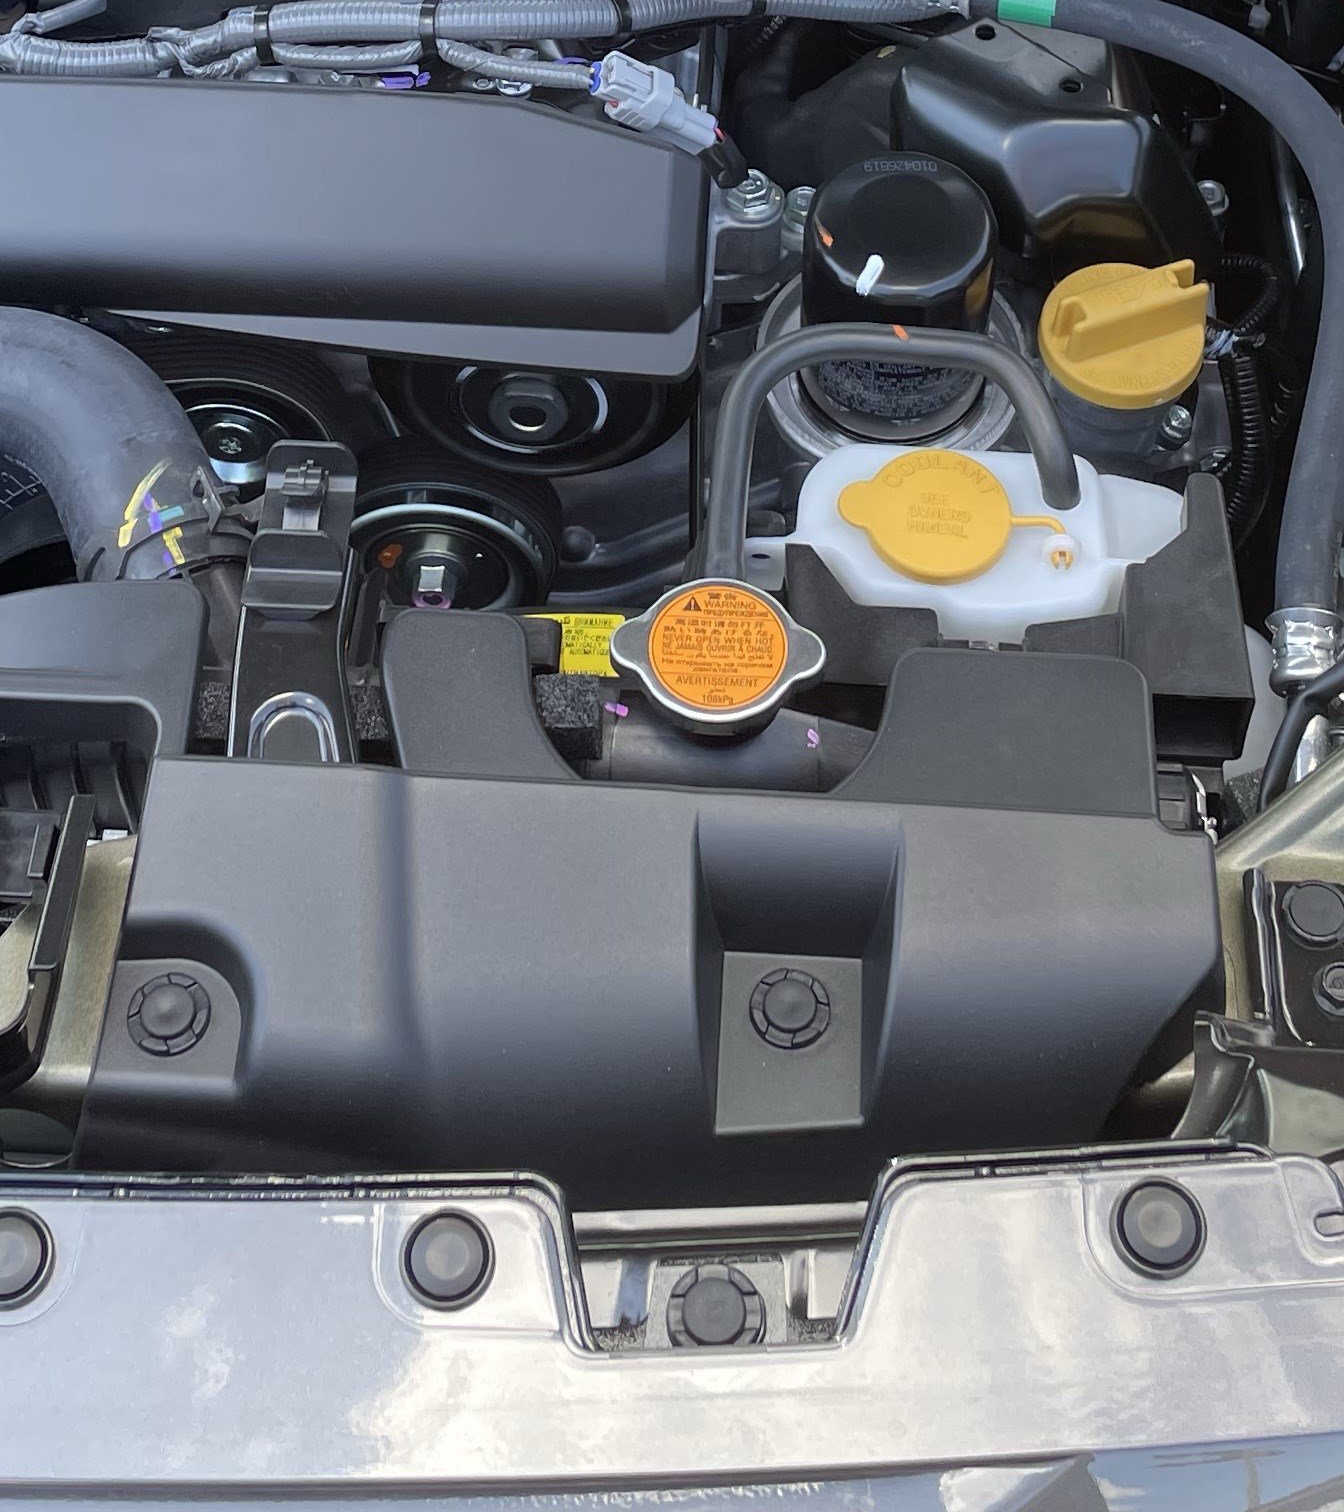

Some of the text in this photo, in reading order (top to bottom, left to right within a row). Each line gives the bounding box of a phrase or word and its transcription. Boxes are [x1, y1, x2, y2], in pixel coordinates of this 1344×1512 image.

[882, 454, 999, 494] COOLANT
[704, 599, 756, 608] WARNING
[662, 633, 773, 645] NEVER OPEN WHEN HOT
[675, 675, 758, 687] AVERTISSEMENT
